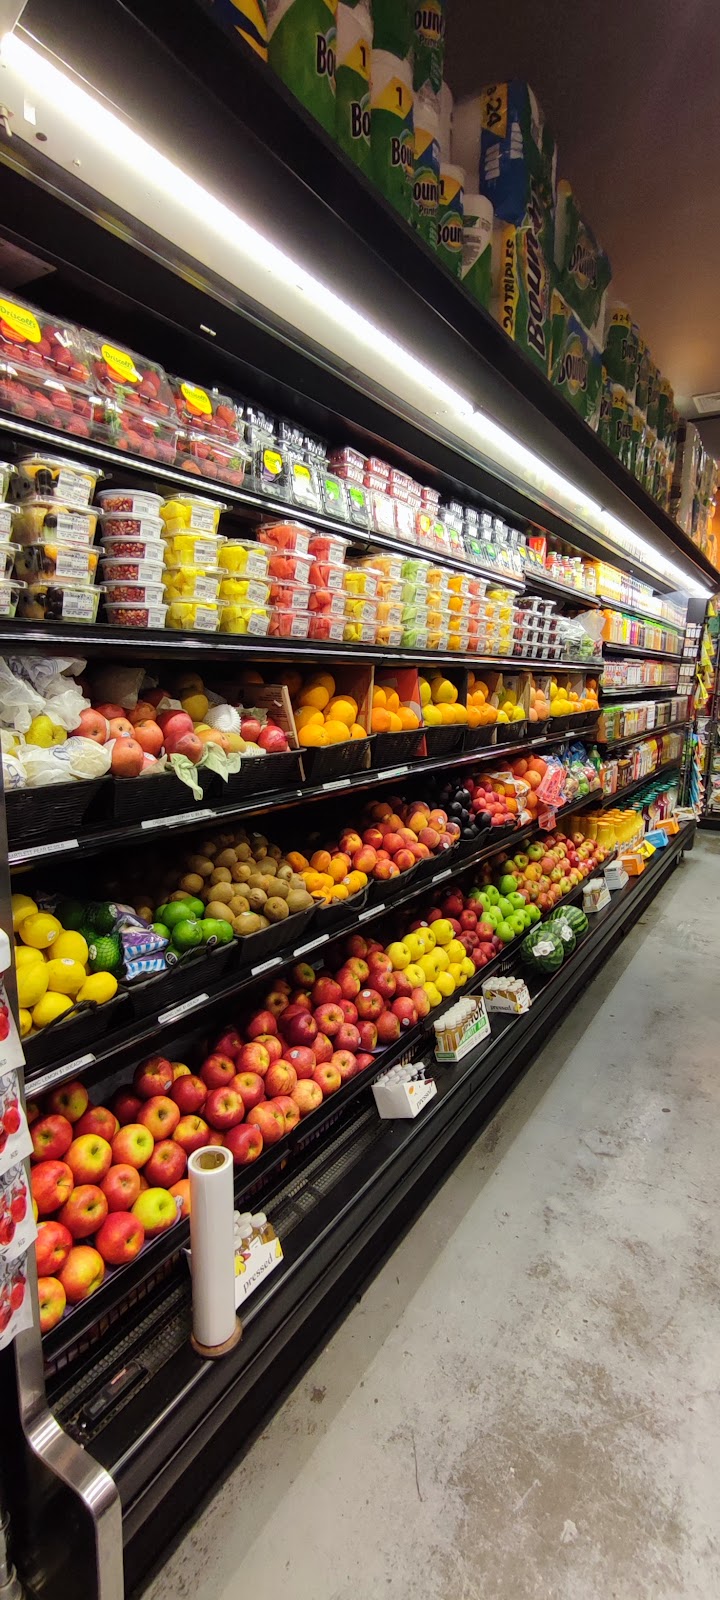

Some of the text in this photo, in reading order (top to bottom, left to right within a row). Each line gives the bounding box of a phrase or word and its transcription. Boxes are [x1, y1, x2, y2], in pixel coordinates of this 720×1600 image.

[360, 46, 366, 68] 1
[396, 86, 403, 107] 1
[503, 238, 514, 304] TRIPLES
[42, 1071, 59, 1082] LEMON
[243, 1252, 273, 1294] pressed
